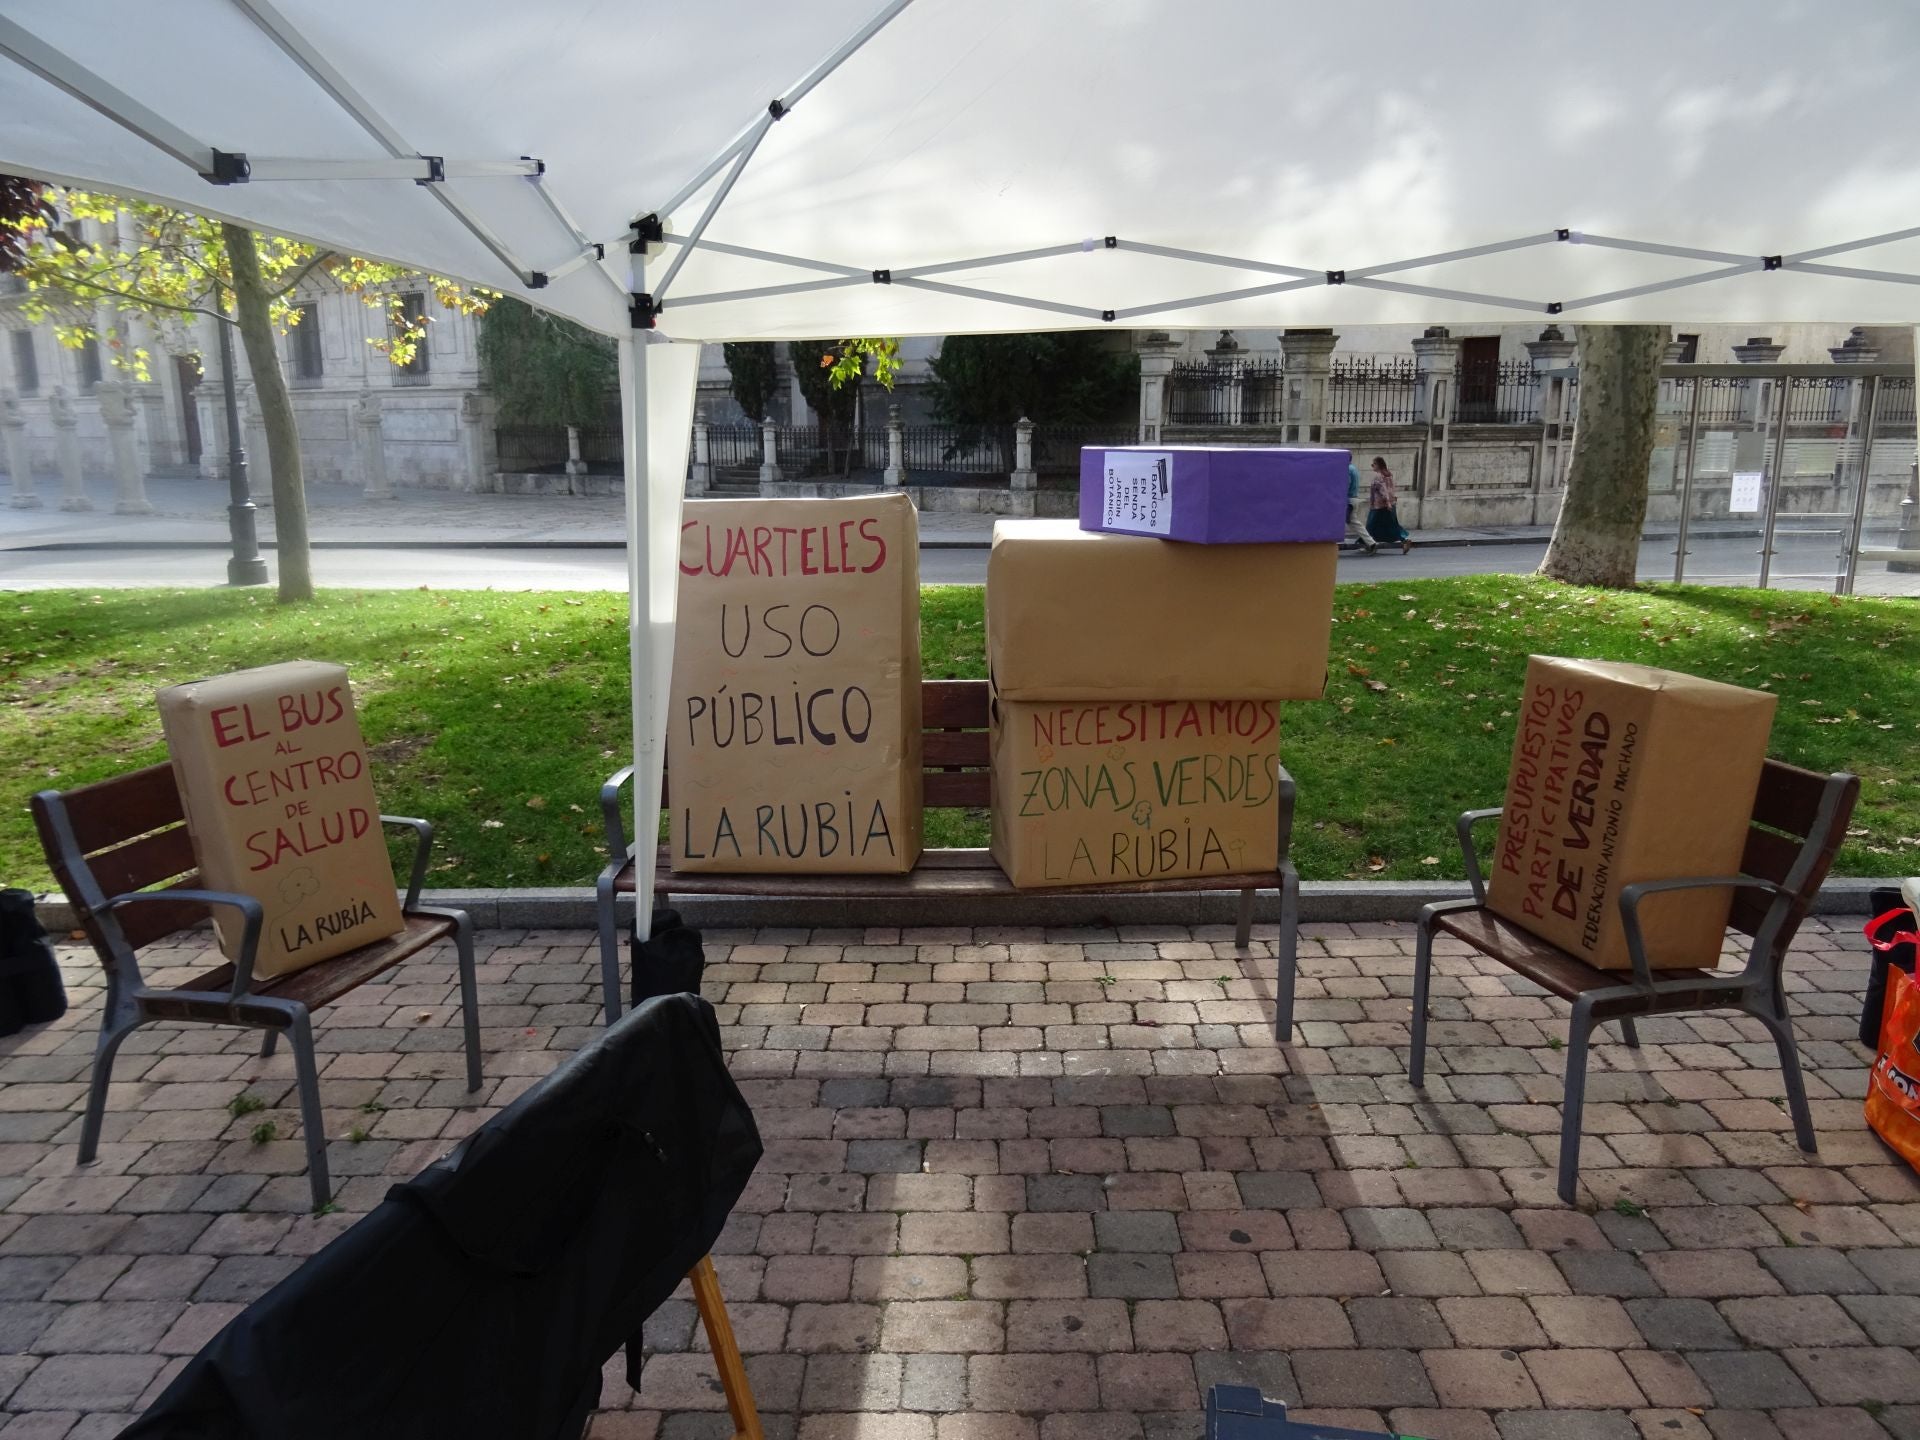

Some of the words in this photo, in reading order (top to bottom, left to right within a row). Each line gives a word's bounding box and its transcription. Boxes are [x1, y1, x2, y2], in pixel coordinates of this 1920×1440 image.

[1139, 505, 1147, 522] LA
[1140, 477, 1147, 495] EN
[1149, 473, 1158, 528] BANCOS
[679, 518, 887, 577] CUARTELES
[722, 604, 840, 658] USO
[210, 704, 270, 748] EL
[278, 687, 343, 732] BUS
[274, 741, 302, 756] AL
[1614, 722, 1638, 792] MACHADO
[224, 751, 362, 806] CENTRO
[1018, 761, 1136, 817] ZONAS
[1153, 753, 1276, 808] VERDES
[1502, 684, 1556, 876] PRESUPUESTOS
[1563, 711, 1610, 850] VERDAD
[285, 801, 312, 819] DE
[684, 807, 742, 859] LA
[246, 808, 370, 871] SALUD
[1044, 837, 1097, 880] LA
[1552, 859, 1583, 921] DE
[281, 924, 312, 952] LA
